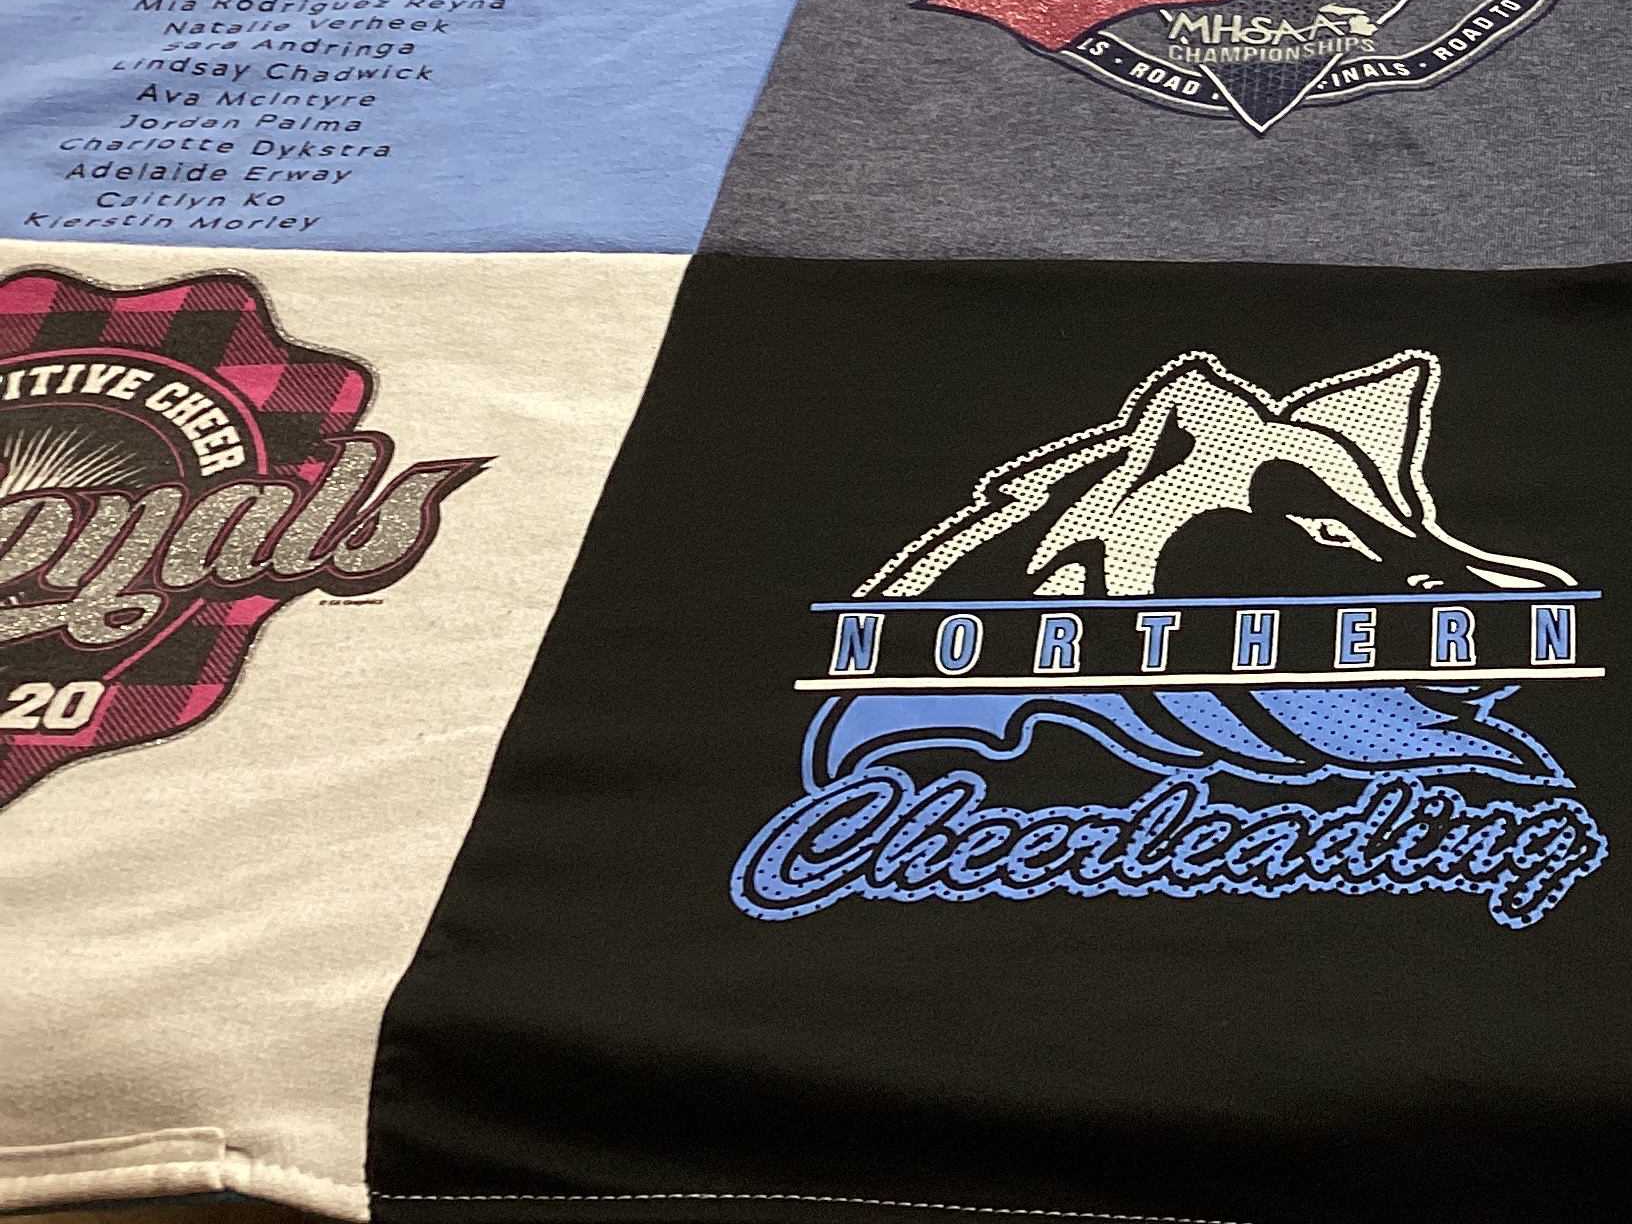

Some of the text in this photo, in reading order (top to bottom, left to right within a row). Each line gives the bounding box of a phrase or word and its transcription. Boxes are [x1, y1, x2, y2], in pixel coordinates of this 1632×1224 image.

[163, 16, 453, 37] Natalie Verheek
[1169, 11, 1349, 45] MHSAA
[1433, 16, 1495, 61] ROAD
[1489, 0, 1522, 19] TO
[250, 38, 417, 60] Andringa
[1169, 38, 1376, 64] CHAMPIONSHIPS
[111, 58, 435, 84] Lindsay Chadwick
[1130, 62, 1202, 96] ROAD
[135, 83, 380, 110] Ava McIntyre
[119, 113, 364, 133] Jordan Palma
[58, 137, 393, 160] Charlotte Dykstra
[64, 160, 354, 185] Adelaide Erway
[95, 191, 286, 211] Caitlyn Ko
[23, 212, 323, 233] Kierstin Morley
[144, 381, 248, 478] CHEER
[828, 604, 1578, 677] NORTHERN
[0, 680, 106, 731] 20
[729, 766, 1611, 931] Cheerleading
